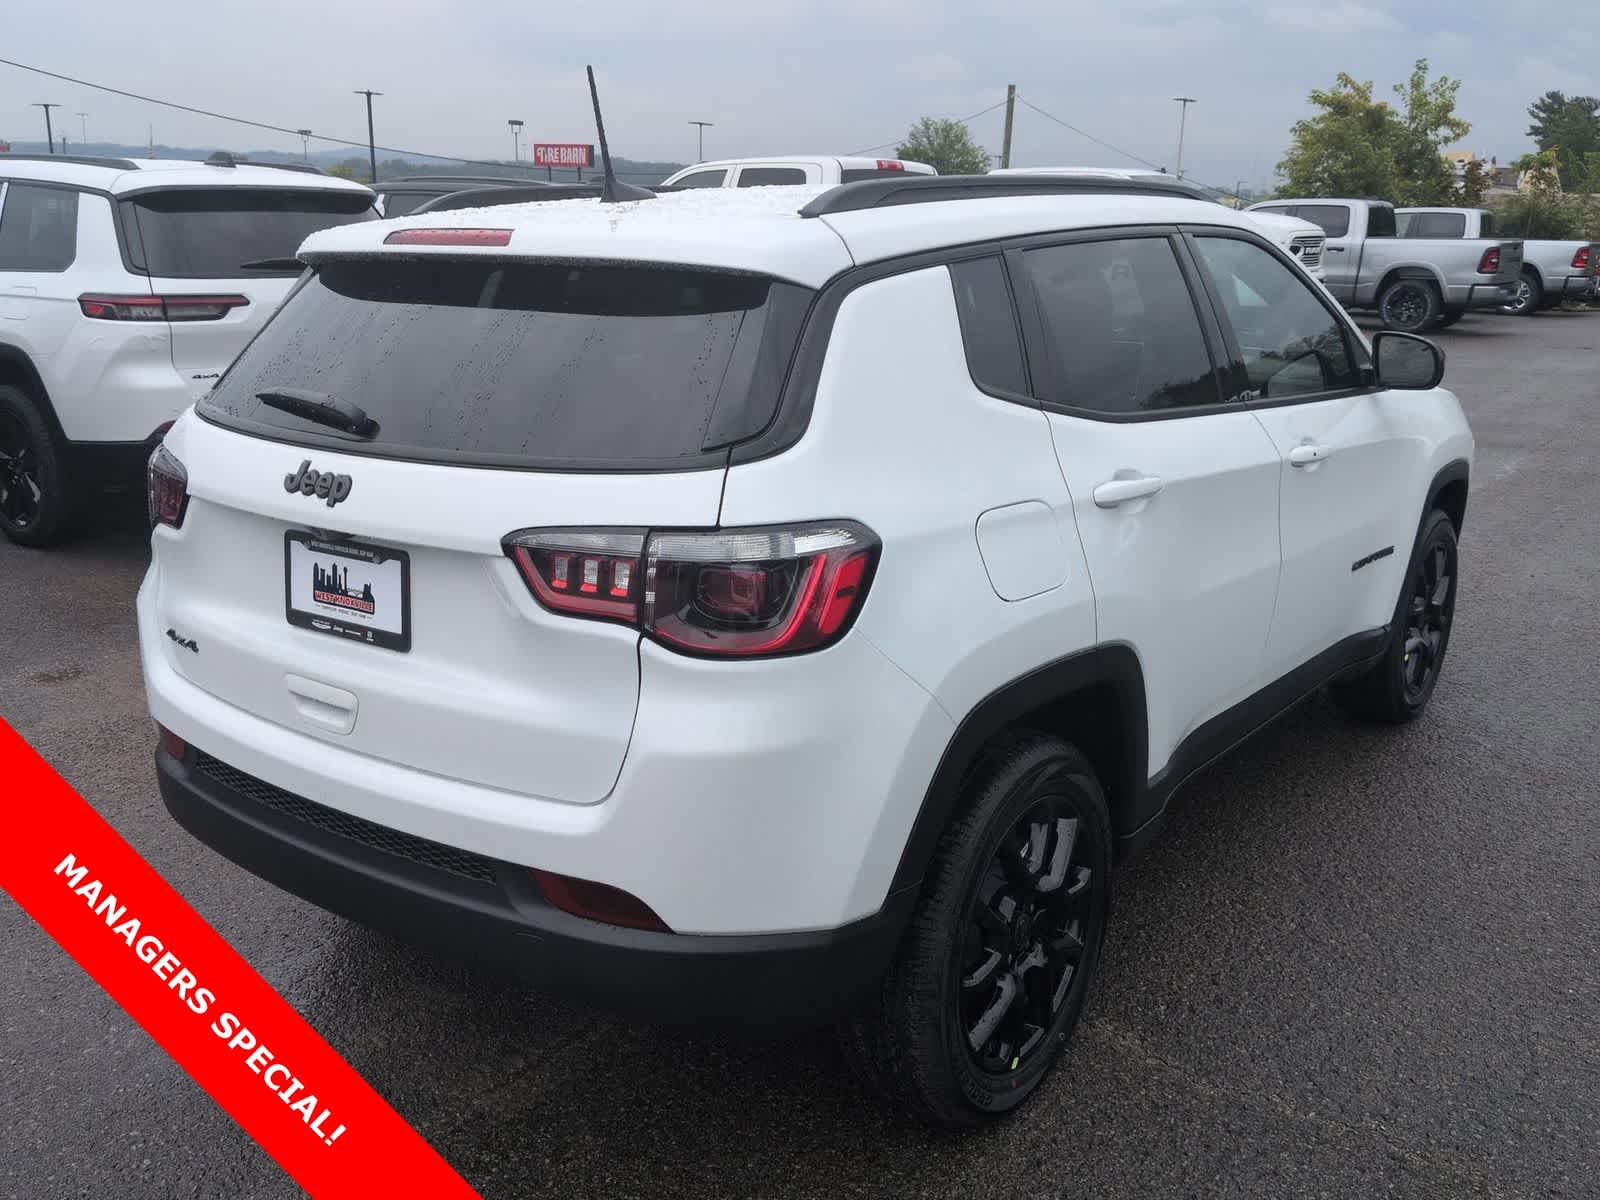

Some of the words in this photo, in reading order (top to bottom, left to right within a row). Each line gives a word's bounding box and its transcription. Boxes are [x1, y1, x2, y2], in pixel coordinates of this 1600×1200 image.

[536, 147, 559, 163] TIRE
[560, 147, 586, 163] BARN
[284, 460, 352, 508] Jeep
[166, 629, 199, 653] 4x4
